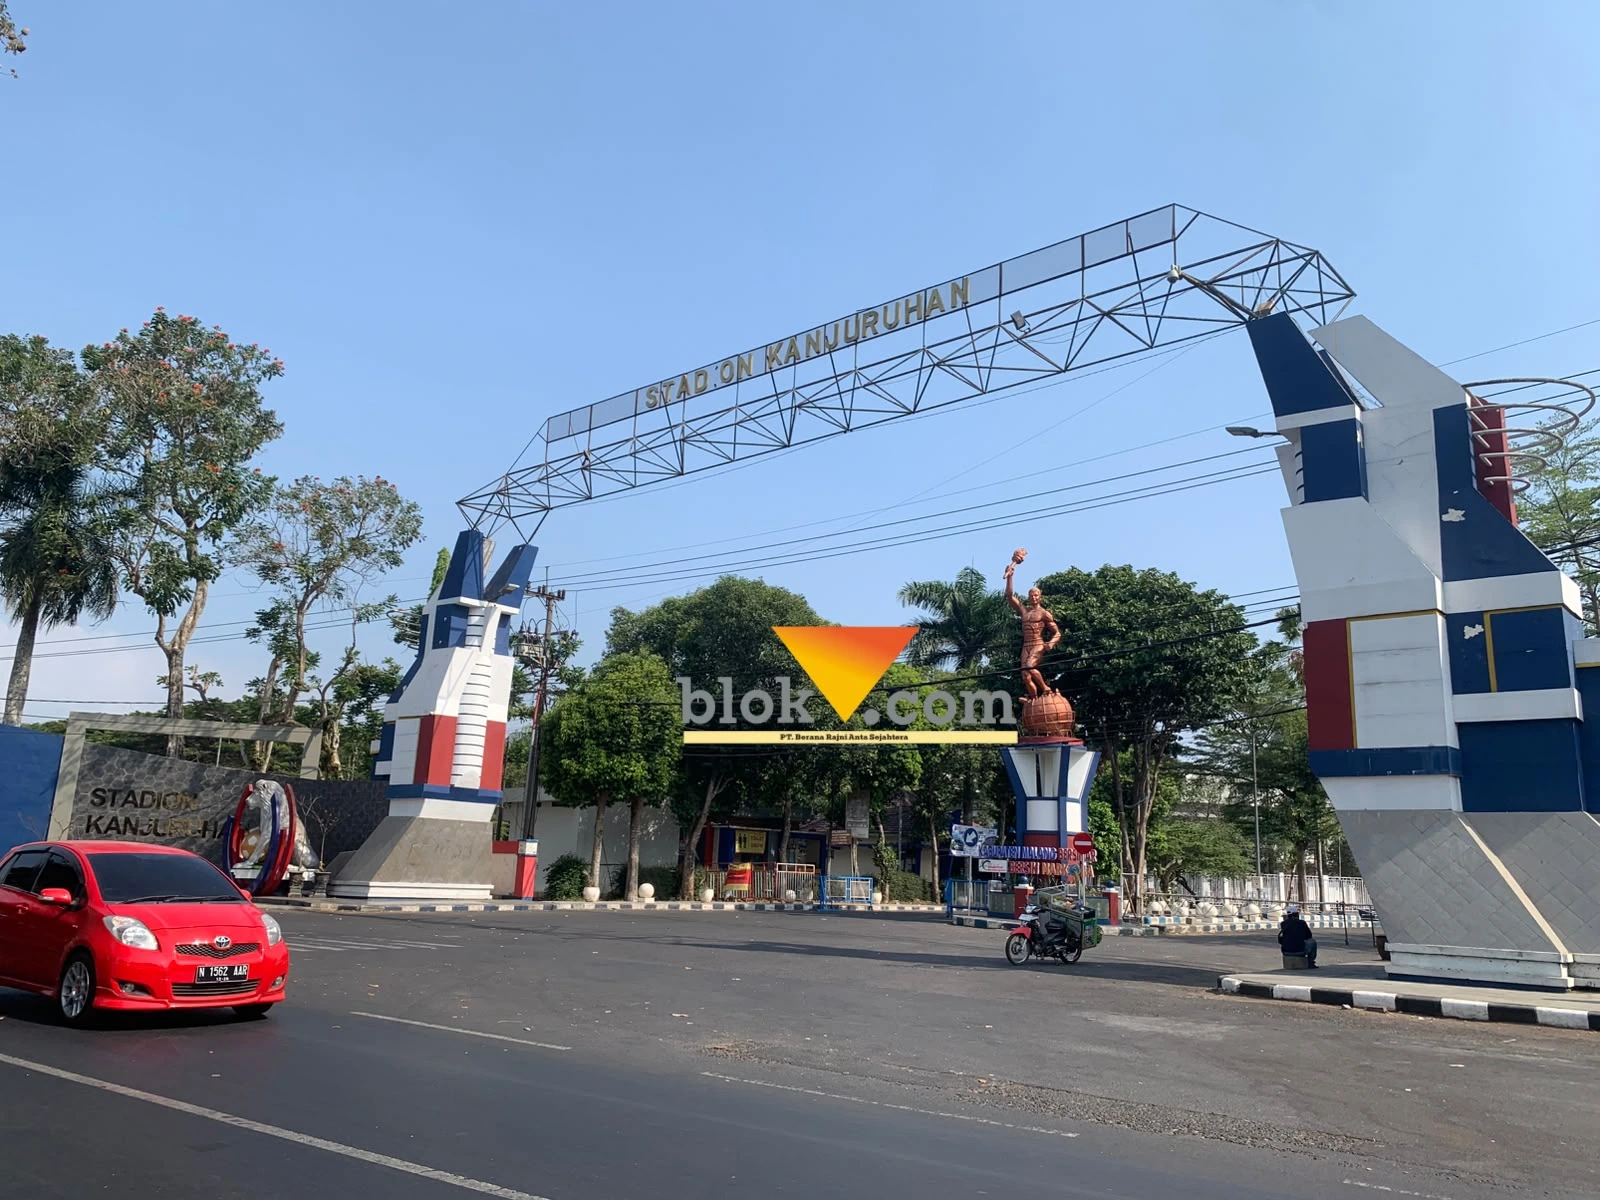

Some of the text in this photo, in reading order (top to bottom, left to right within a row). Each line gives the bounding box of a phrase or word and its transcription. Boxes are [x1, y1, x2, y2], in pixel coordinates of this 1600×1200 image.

[645, 277, 969, 409] STADON KANJURUHAN
[90, 787, 199, 811] STADION
[84, 814, 227, 839] KANJURUHA
[1022, 846, 1058, 861] MALANG
[1008, 861, 1041, 875] BERSIH
[199, 965, 248, 978] N 1562 AAR
